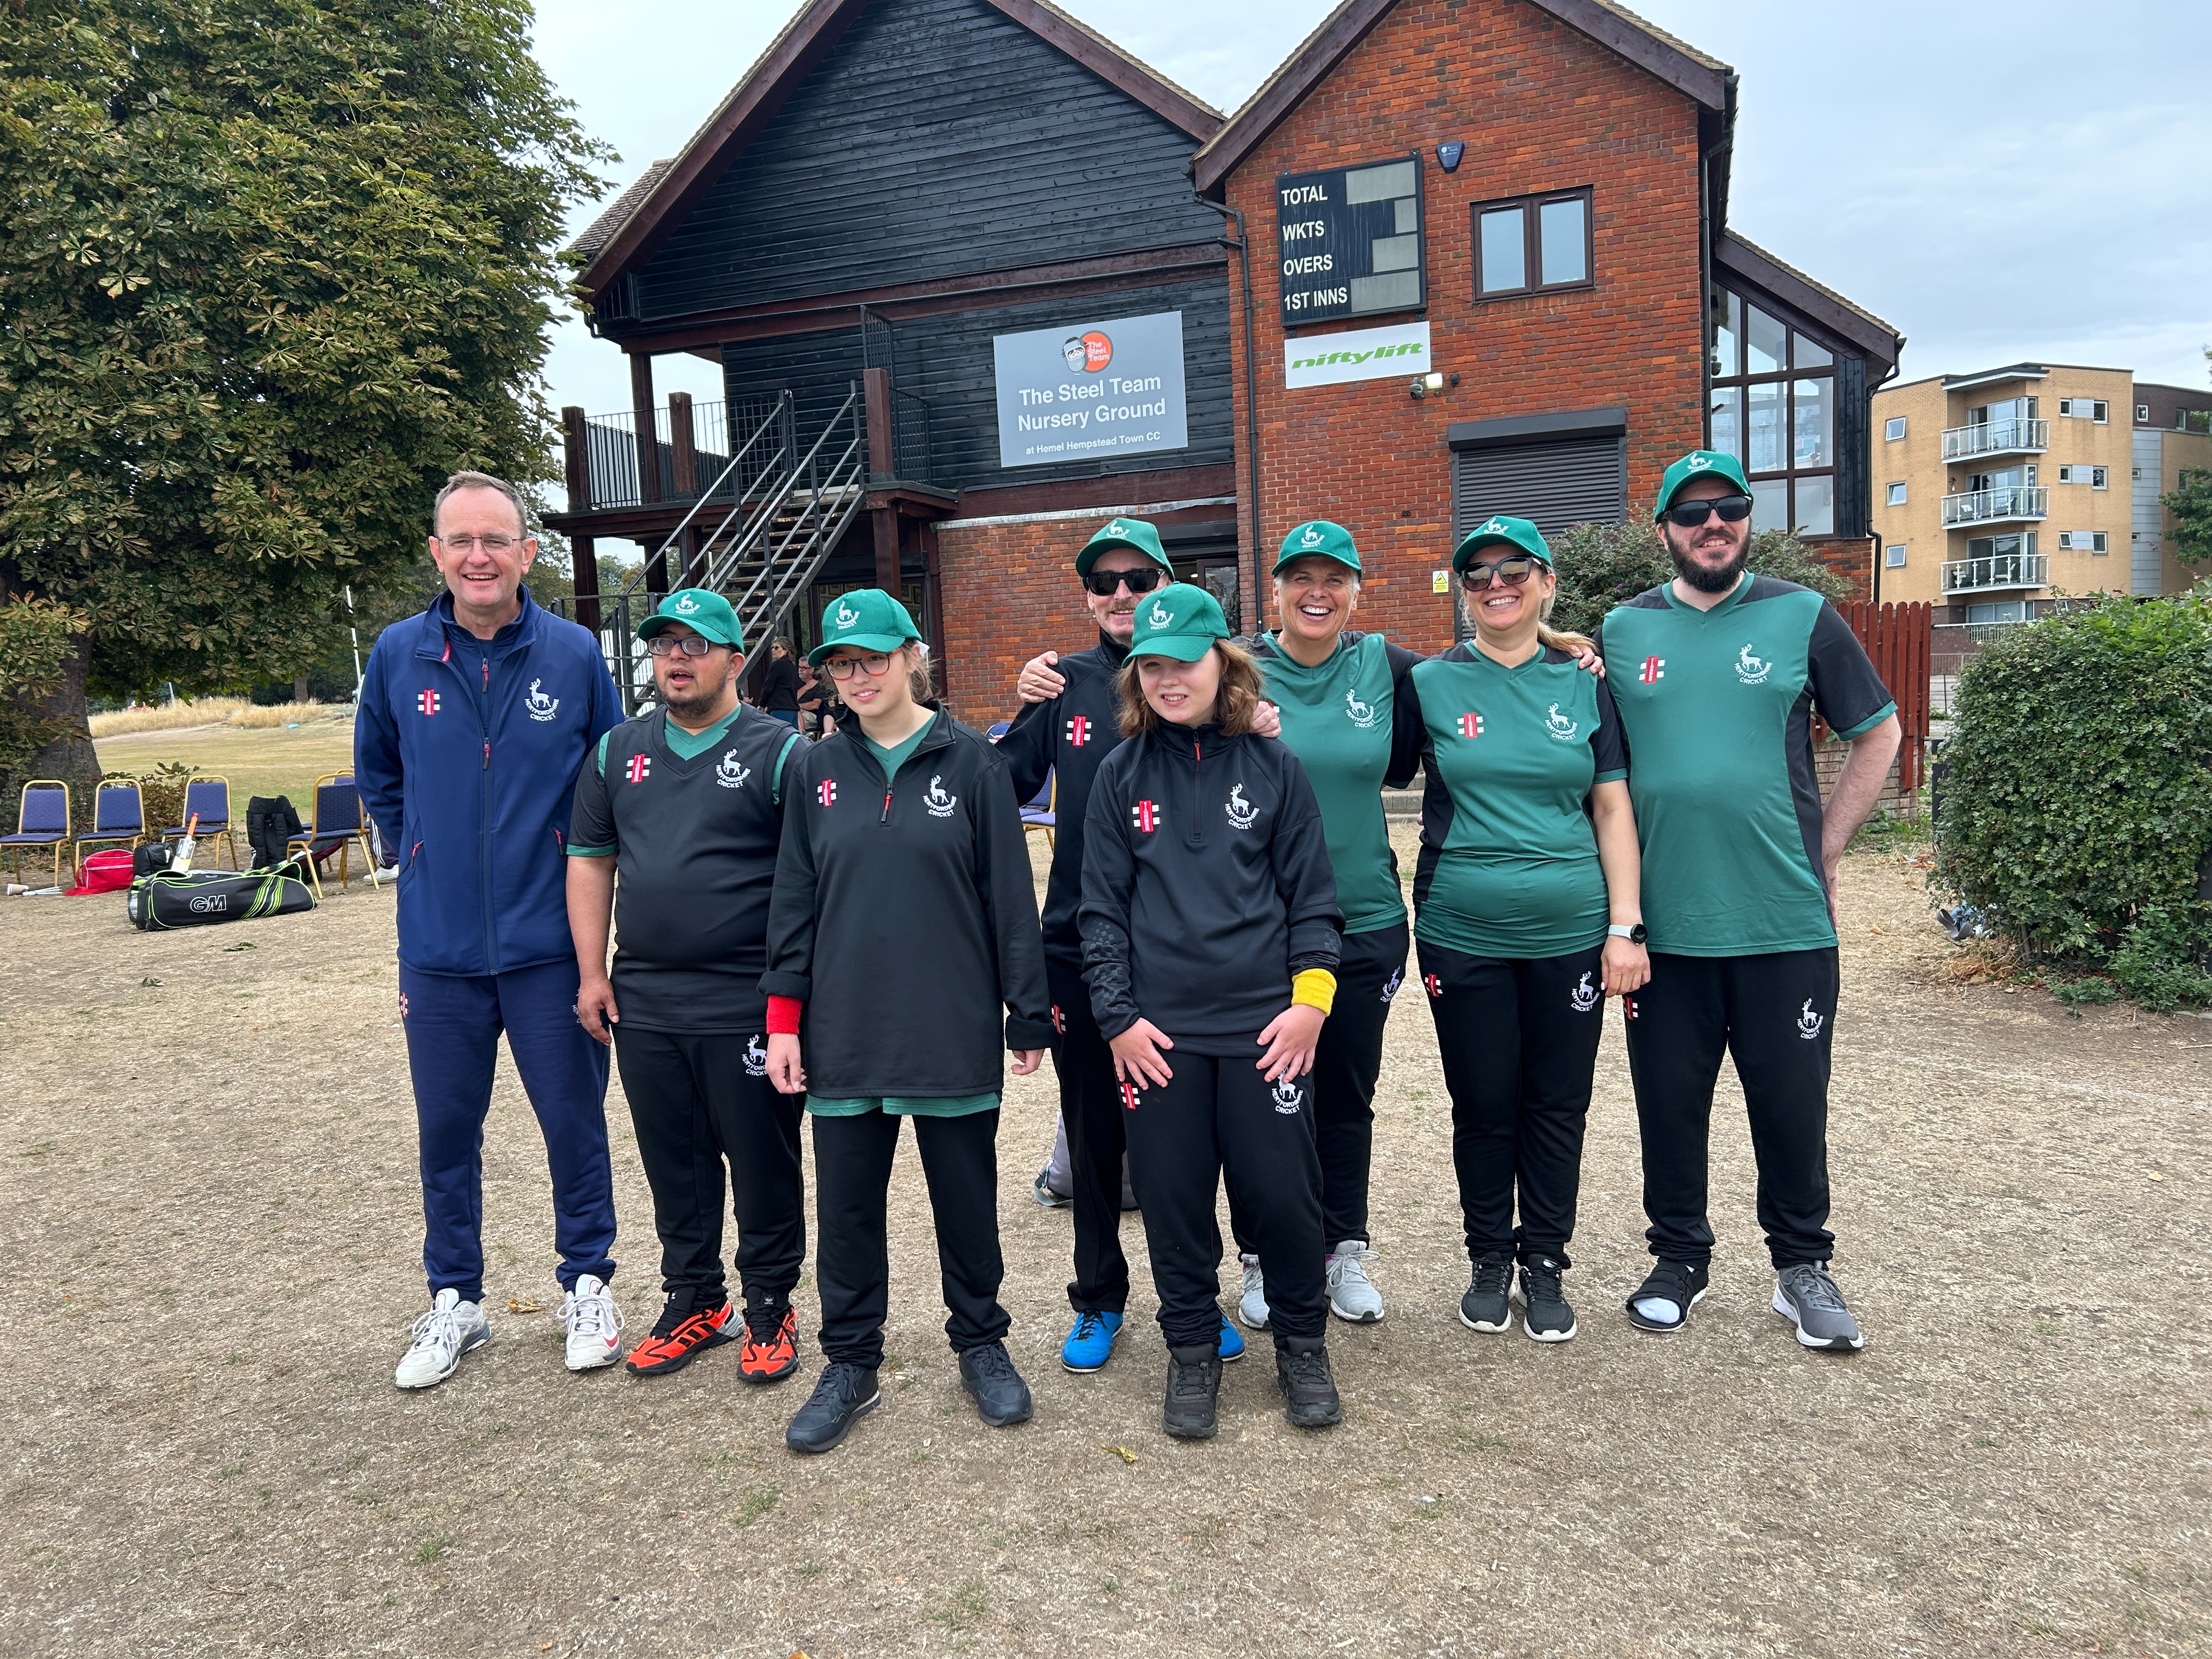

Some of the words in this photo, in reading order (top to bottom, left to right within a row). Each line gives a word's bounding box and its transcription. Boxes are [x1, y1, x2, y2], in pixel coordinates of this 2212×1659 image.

[1282, 185, 1328, 206] TOTAL
[1283, 220, 1324, 241] WKTS
[1284, 254, 1333, 275] OVERS
[1284, 292, 1309, 311] 1ST
[1313, 287, 1347, 307] INNS
[1088, 347, 1107, 355] Steel
[1088, 354, 1110, 362] Team
[1291, 343, 1423, 369] niftylift
[1019, 388, 1053, 406] The
[1058, 380, 1104, 402] Steel
[1109, 376, 1161, 395] Team
[1018, 411, 1089, 432] Nursery
[1095, 398, 1166, 422] Ground
[1025, 446, 1034, 455] at
[1036, 444, 1064, 454] Hemel
[1066, 436, 1117, 450] Hempstead
[1119, 435, 1144, 444] Town
[1146, 431, 1161, 441] CC
[1734, 662, 1772, 678] HERTFORDSHIRE
[1739, 675, 1767, 684] CRICKET
[524, 698, 559, 715] HERTFORDSHIRE
[530, 713, 556, 721] CRICKET
[716, 765, 751, 782] HERTFORDSHIRE
[717, 779, 743, 788] CRICKET
[1225, 803, 1260, 823] HERTFORDSHIRE
[1228, 819, 1252, 830] CRICKET
[190, 894, 227, 913] GM
[1571, 1003, 1593, 1011] CRICKET
[1801, 1029, 1819, 1039] CRICKET
[1272, 1088, 1304, 1108] HERTFORDSHIRE
[1276, 1105, 1300, 1114] CRICKET
